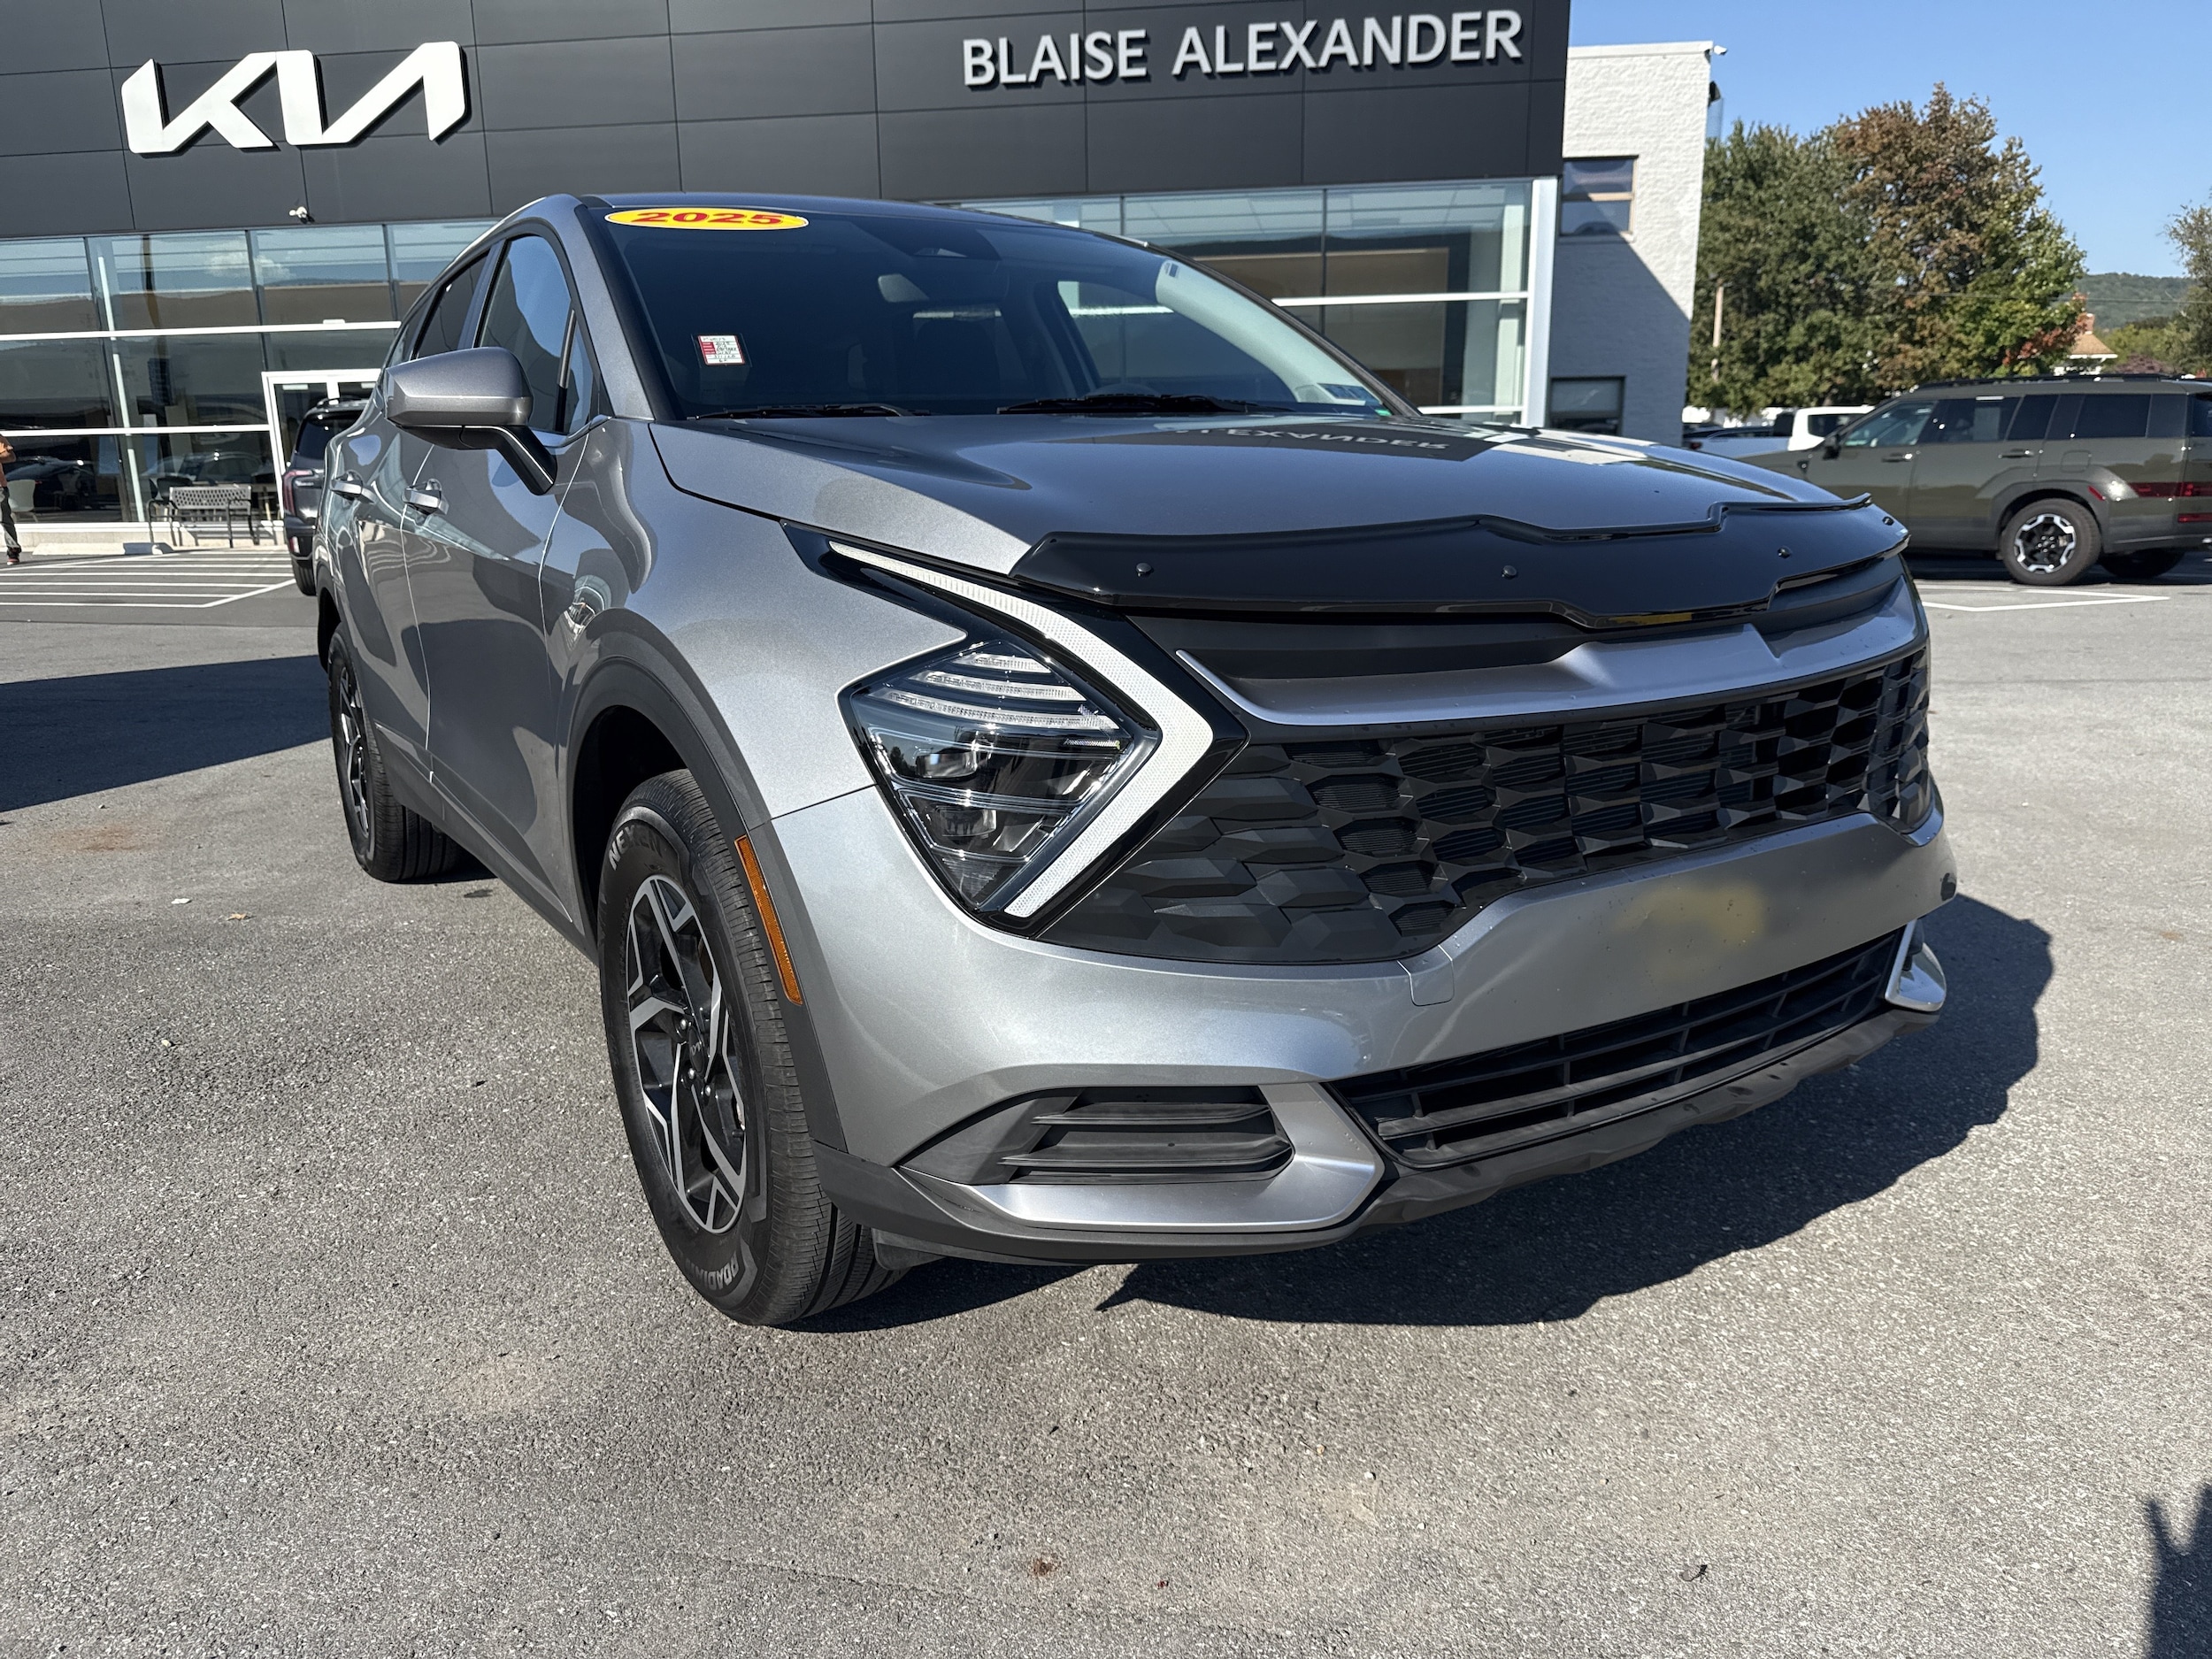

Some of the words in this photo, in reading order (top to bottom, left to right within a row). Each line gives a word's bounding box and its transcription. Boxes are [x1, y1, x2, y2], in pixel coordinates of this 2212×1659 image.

[962, 28, 1148, 88] BLAISE
[1171, 9, 1524, 75] ALEXANDER
[121, 41, 467, 154] KIA
[631, 211, 784, 225] 2025
